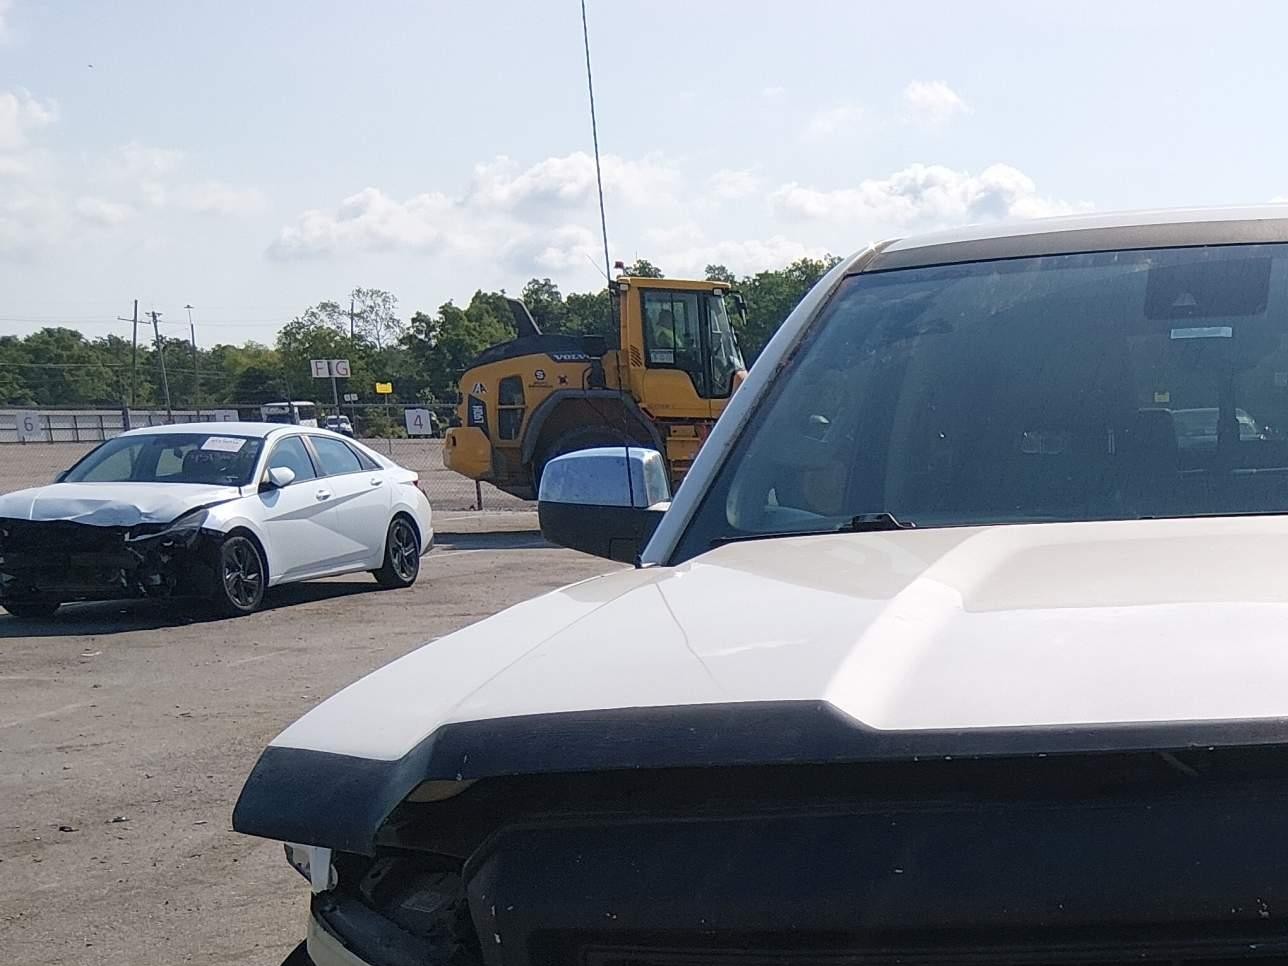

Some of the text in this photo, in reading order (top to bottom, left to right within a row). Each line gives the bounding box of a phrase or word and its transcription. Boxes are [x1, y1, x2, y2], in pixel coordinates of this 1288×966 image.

[315, 361, 323, 376] F
[336, 361, 348, 375] G
[24, 417, 33, 431] 6
[413, 414, 423, 429] 4
